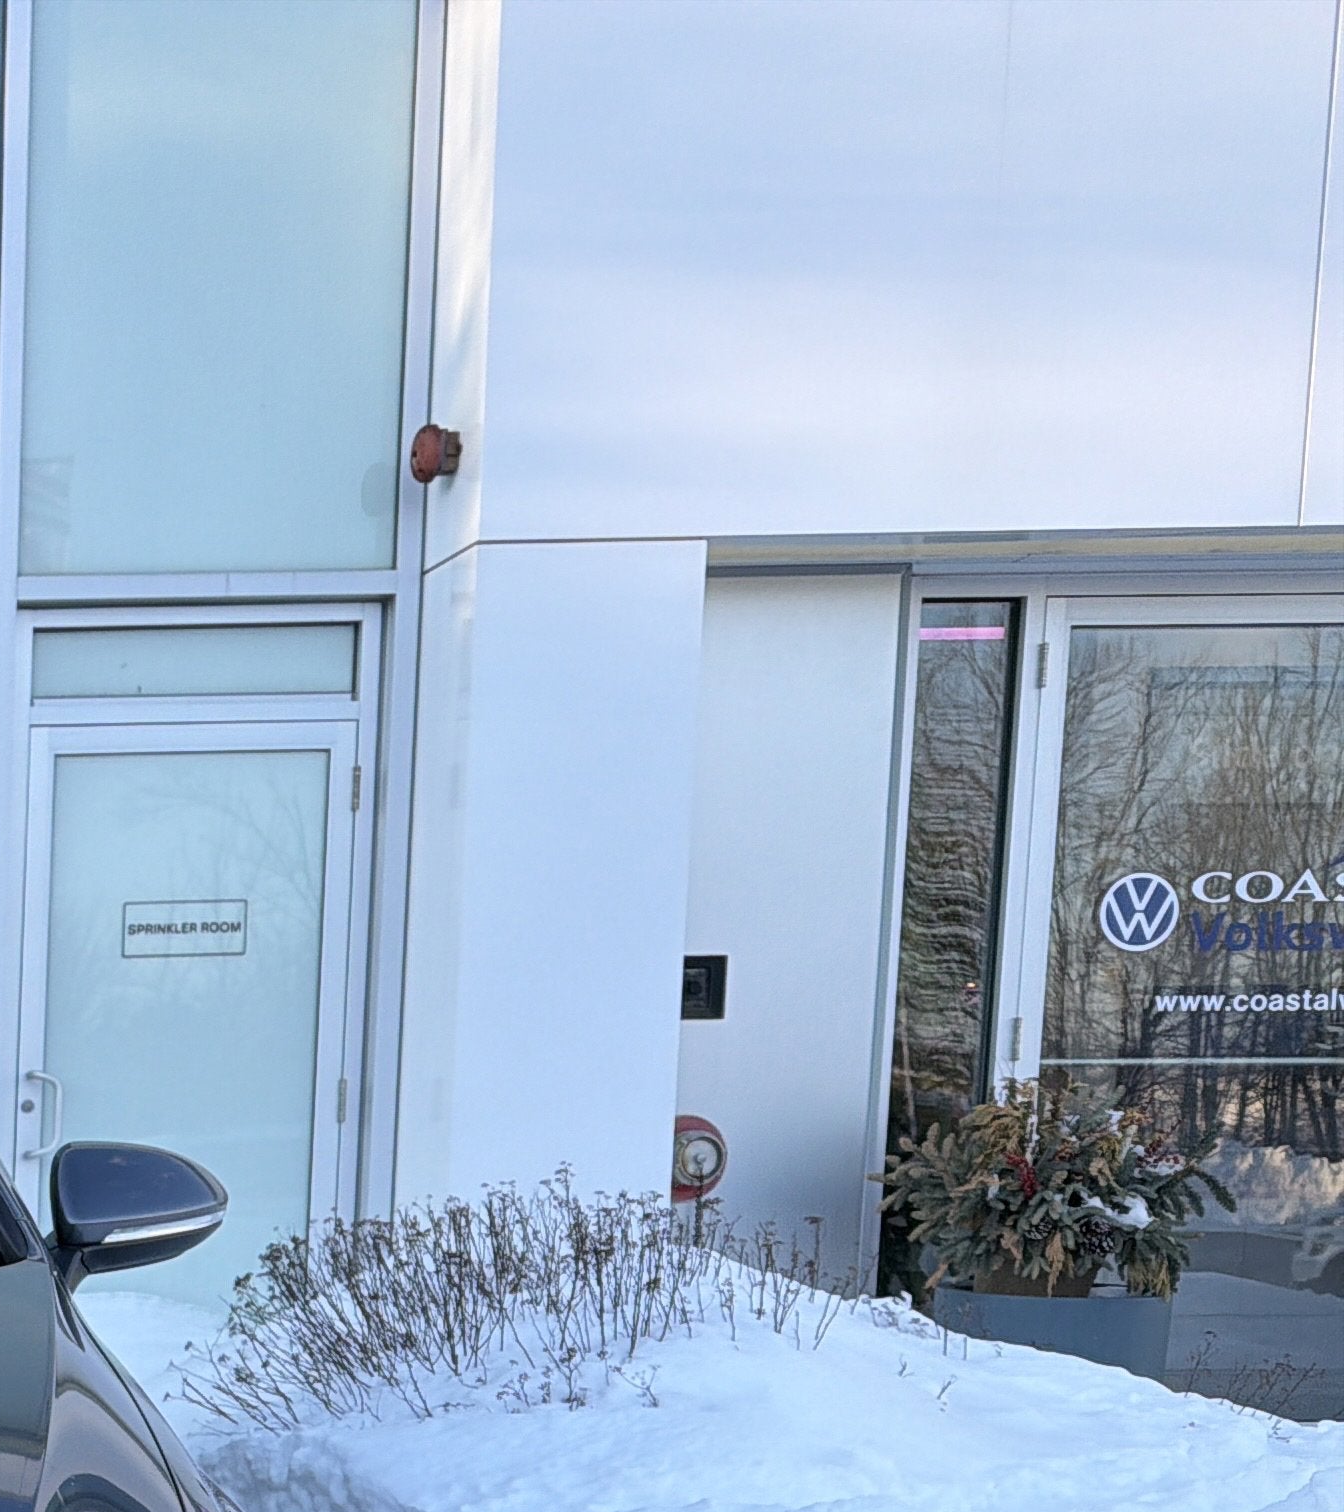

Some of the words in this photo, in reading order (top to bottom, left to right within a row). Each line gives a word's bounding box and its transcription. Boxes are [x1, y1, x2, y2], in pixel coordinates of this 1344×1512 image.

[1191, 868, 1344, 903] COA
[128, 922, 197, 936] SPRINKLER
[201, 921, 242, 934] ROOM
[1155, 987, 1344, 1013] www.coastal
